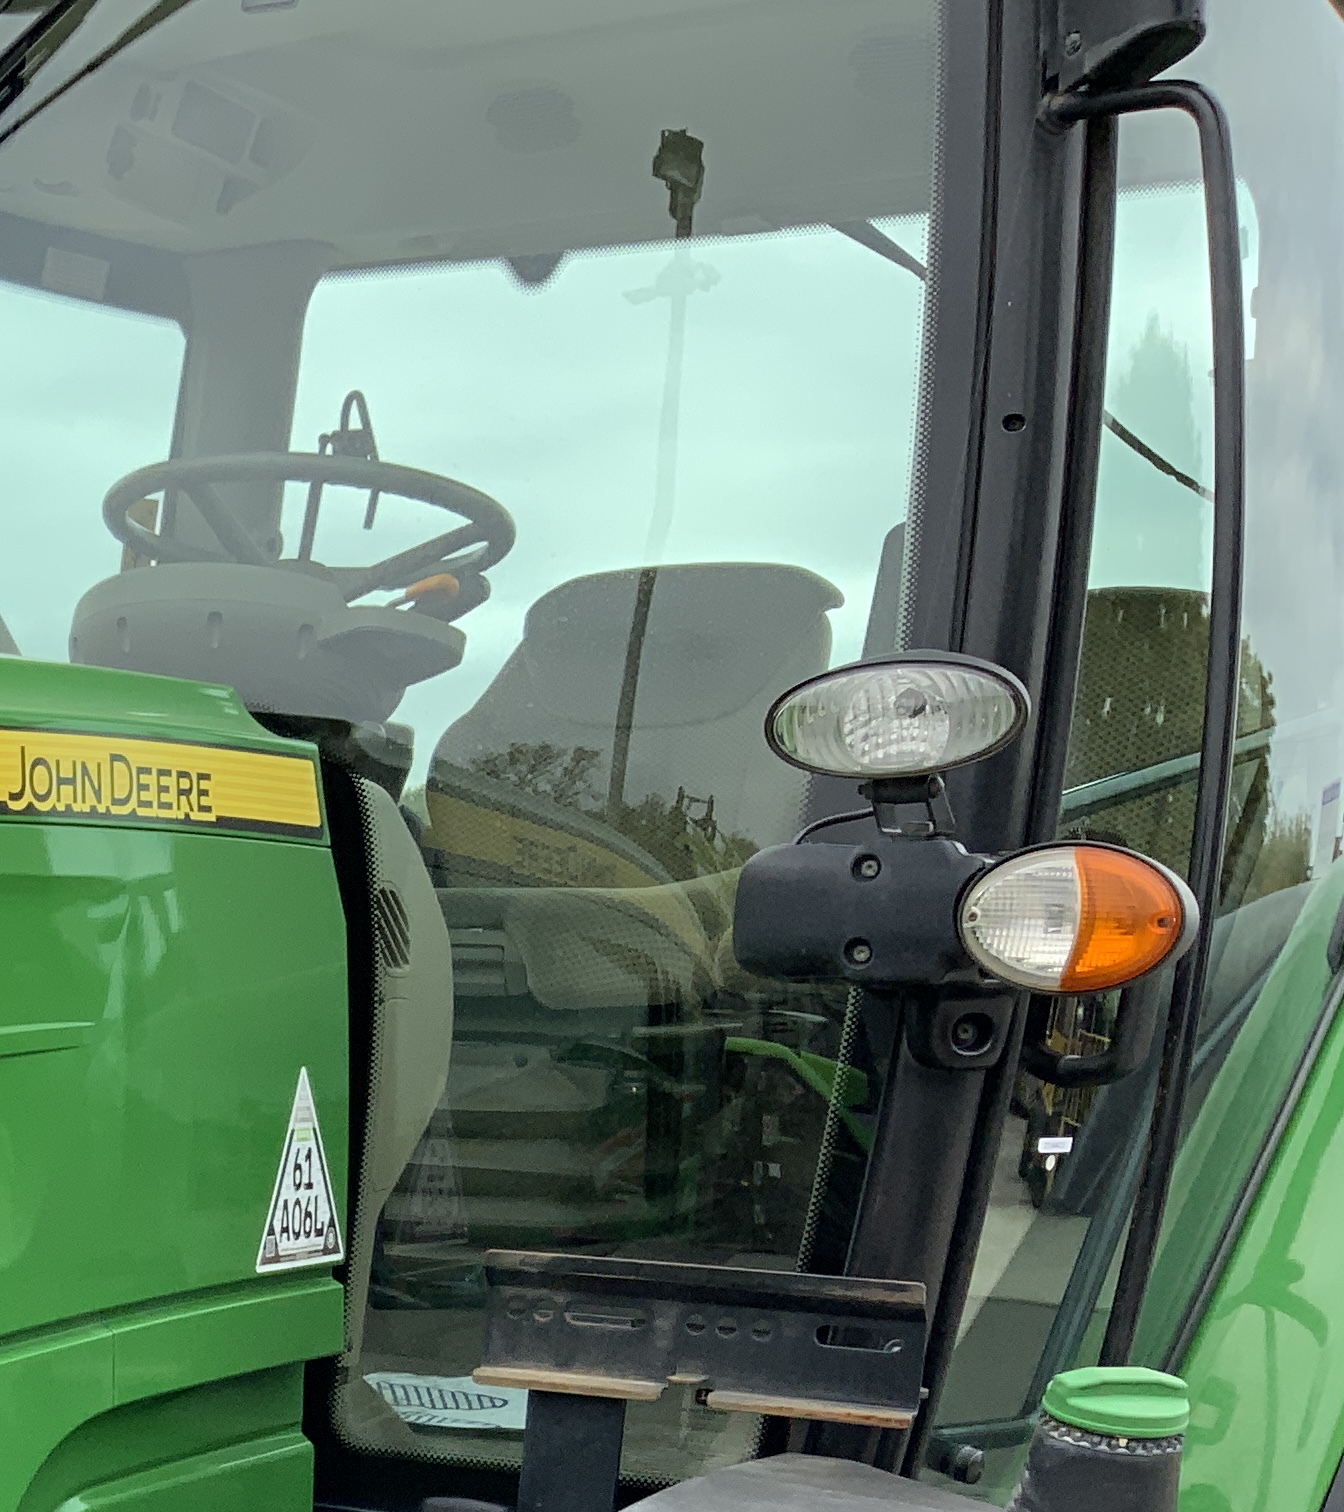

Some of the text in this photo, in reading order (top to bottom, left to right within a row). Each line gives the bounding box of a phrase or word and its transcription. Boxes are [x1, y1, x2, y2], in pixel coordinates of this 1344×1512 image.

[7, 745, 213, 814] JOHN DEERE
[292, 1146, 314, 1191] 61
